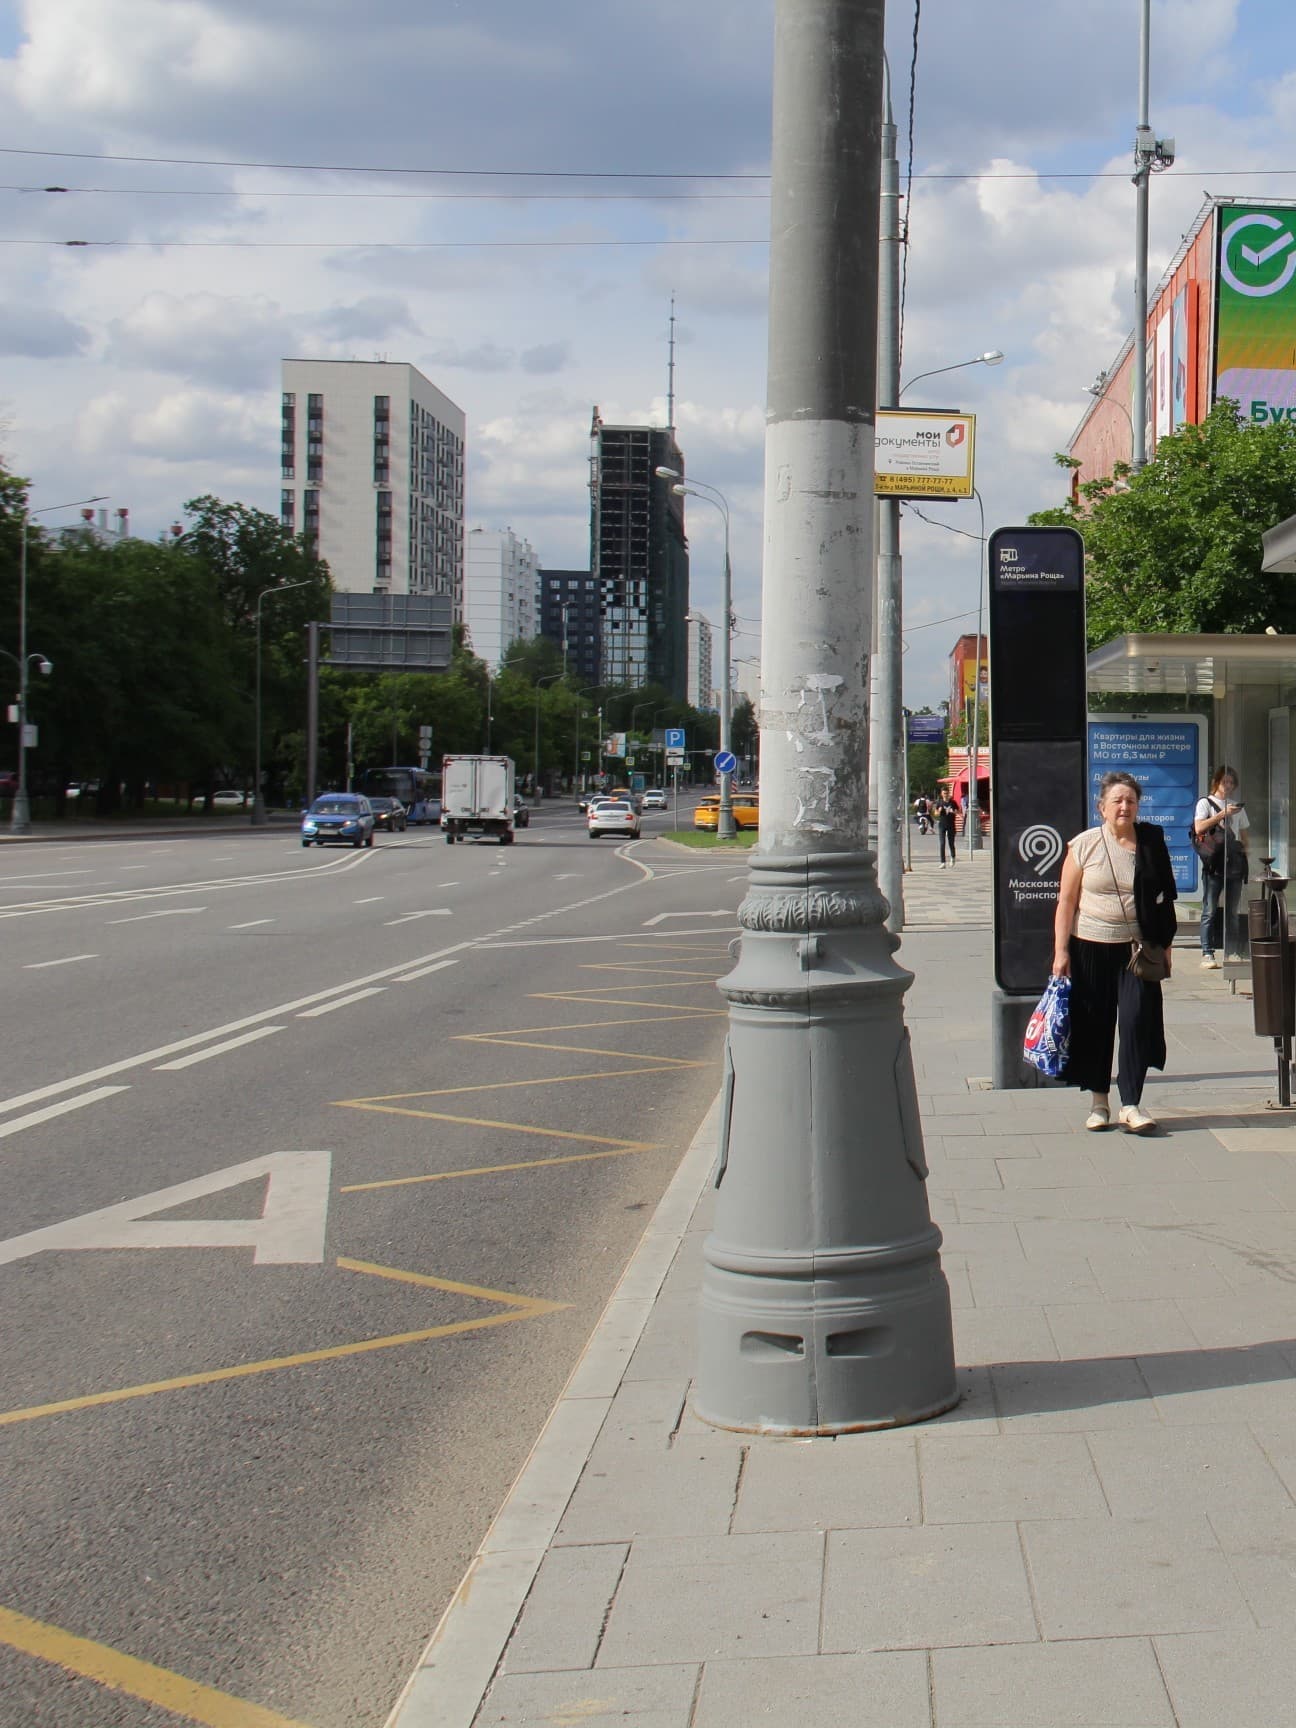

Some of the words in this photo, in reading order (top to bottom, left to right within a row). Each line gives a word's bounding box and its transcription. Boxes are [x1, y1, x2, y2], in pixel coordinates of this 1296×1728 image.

[1000, 565, 1026, 573] Метро
[1041, 572, 1064, 580] Роща»
[1093, 732, 1137, 742] Квартиры
[1139, 734, 1155, 742] для
[1100, 742, 1149, 750] Восточном
[1151, 743, 1191, 752] кластере
[1008, 879, 1060, 889] Московск
[1013, 890, 1060, 902] Транспо
